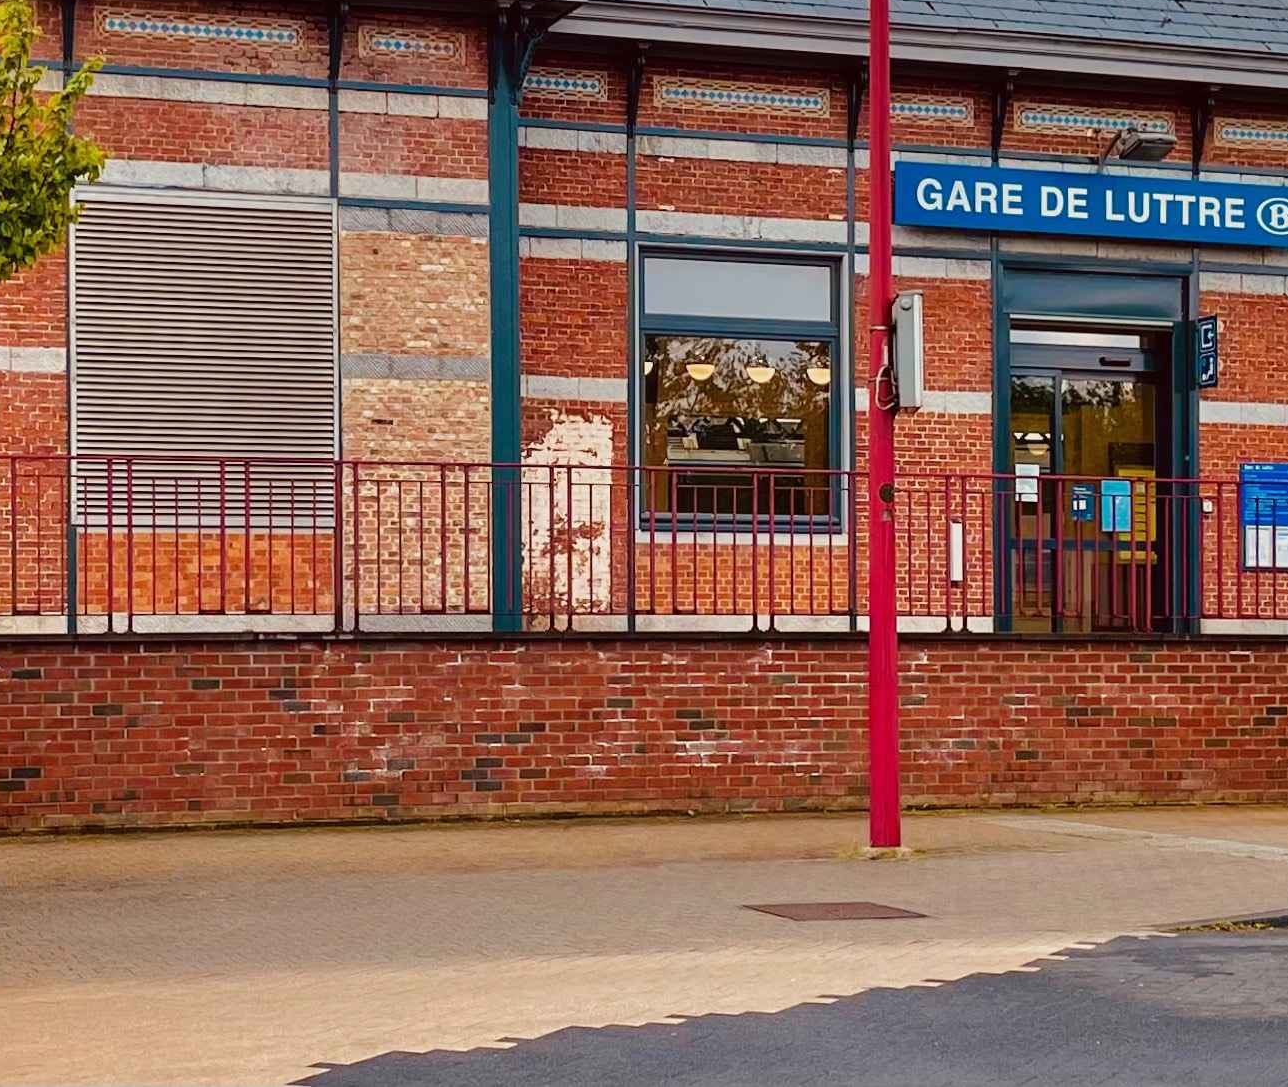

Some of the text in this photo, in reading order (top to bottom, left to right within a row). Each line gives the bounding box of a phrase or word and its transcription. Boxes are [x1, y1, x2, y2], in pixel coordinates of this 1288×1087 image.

[916, 177, 1024, 215] GARE
[1040, 185, 1089, 219] DE
[1105, 189, 1246, 229] LUTTRE
